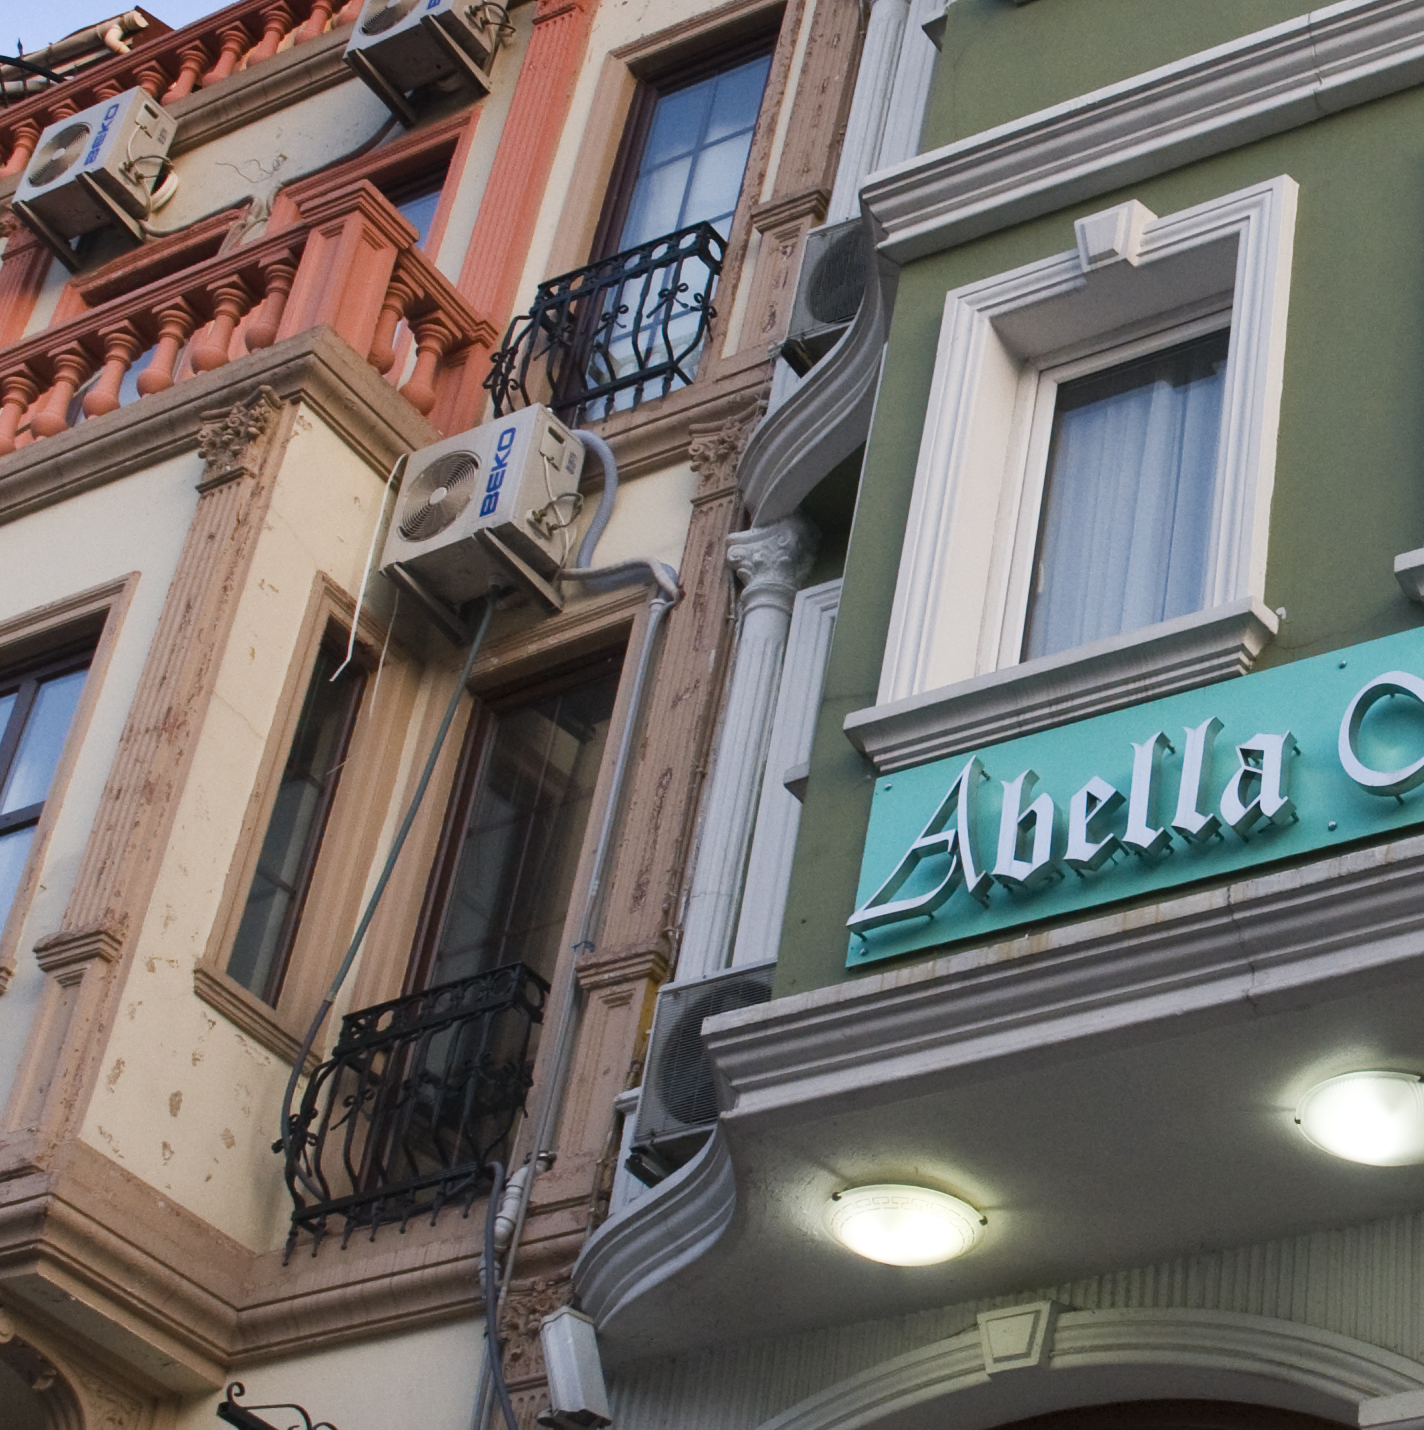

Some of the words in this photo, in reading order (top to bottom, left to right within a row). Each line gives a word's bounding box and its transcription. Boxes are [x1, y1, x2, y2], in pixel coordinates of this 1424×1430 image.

[84, 103, 119, 166] BEKO
[480, 427, 516, 517] BEKO
[847, 716, 1297, 934] Abella
